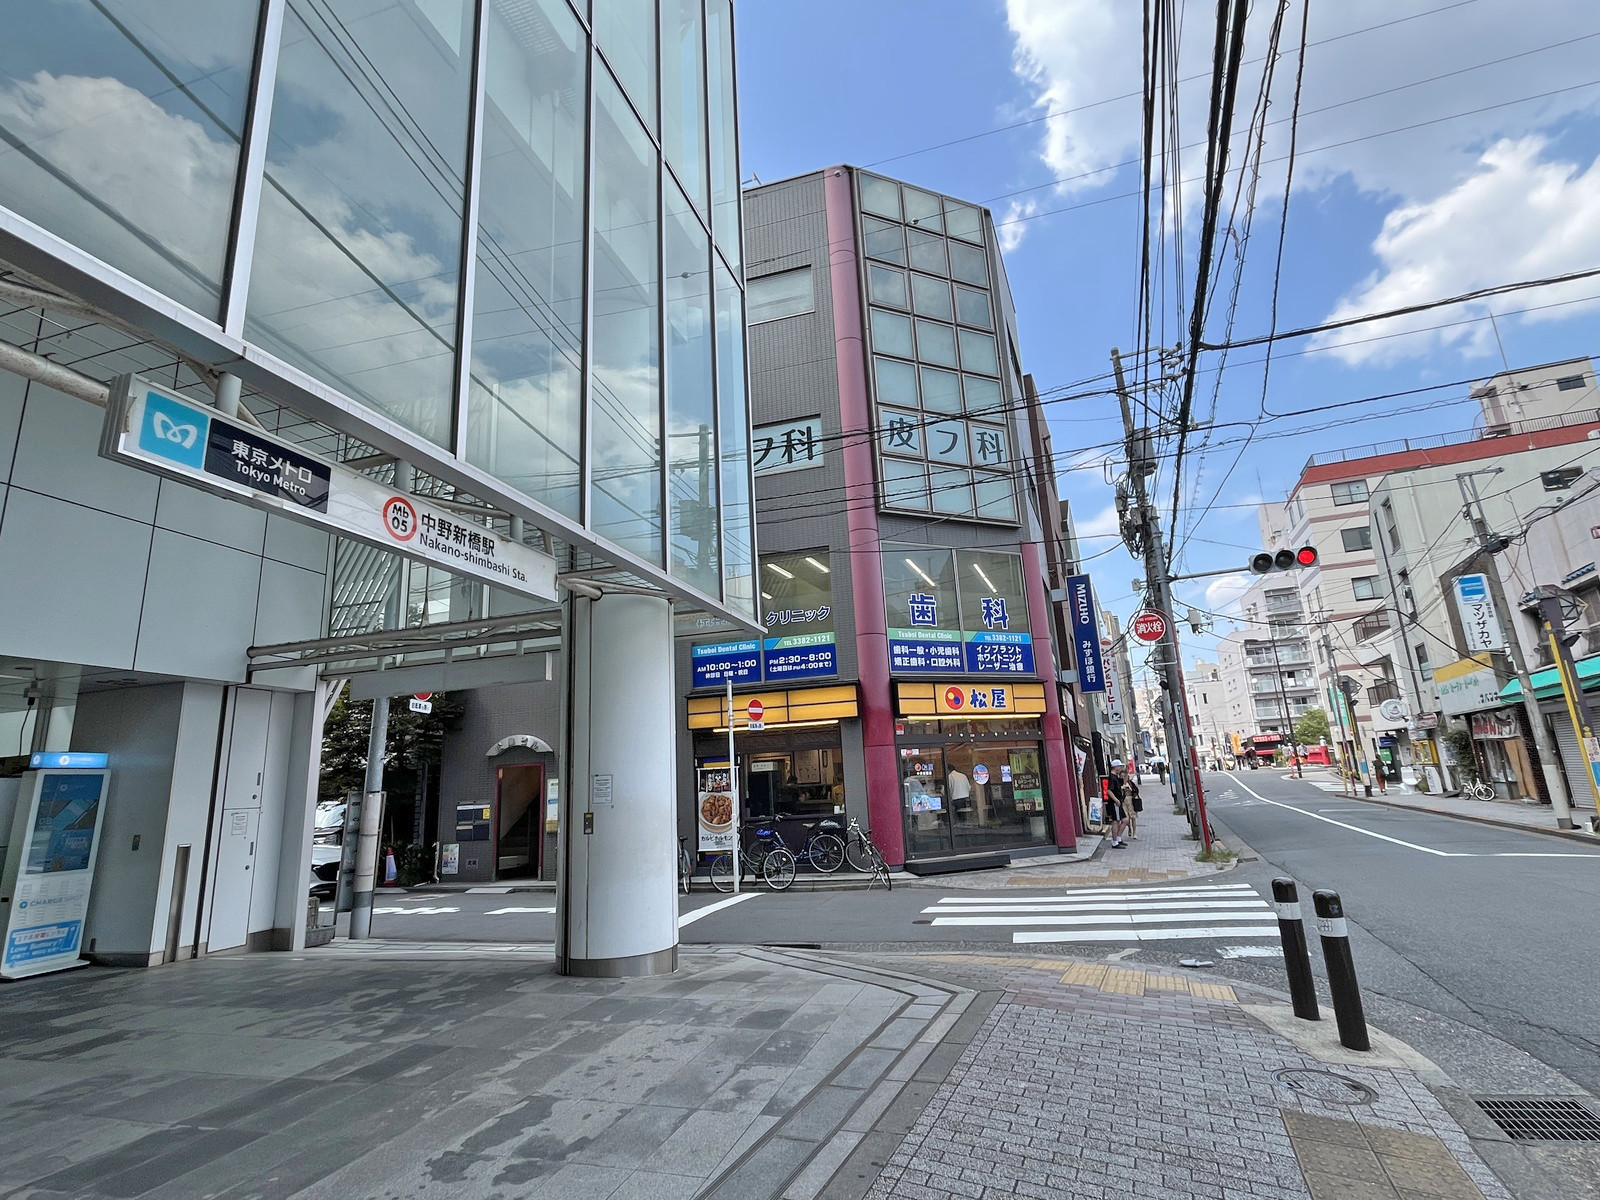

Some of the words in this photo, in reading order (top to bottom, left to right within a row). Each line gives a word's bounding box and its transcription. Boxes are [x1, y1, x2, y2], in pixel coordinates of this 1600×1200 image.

[887, 416, 1004, 464] 皮フ科
[231, 439, 313, 484] 東京メトロ
[235, 460, 271, 482] Tokyo
[273, 474, 306, 496] Metro
[391, 503, 410, 519] Mb
[391, 516, 408, 533] 05
[420, 513, 495, 558] 中野新橋駅
[419, 532, 511, 577] Nakano-shimbashi
[512, 568, 528, 583] Sta.
[1075, 583, 1090, 625] MIZUHO
[765, 605, 831, 627] クリニック
[1471, 603, 1492, 648] マツザカヤ
[918, 631, 937, 639] Dental
[937, 632, 953, 640] Clinic
[1136, 620, 1163, 635] 消火栓
[697, 646, 717, 655] Tsuboi
[717, 645, 738, 653] Dental
[738, 643, 756, 651] Clinic
[976, 645, 1022, 653] インプラント
[977, 653, 1022, 662] ホワイトニング
[1082, 640, 1097, 683] みずほ銀行
[969, 688, 1007, 709] 松屋
